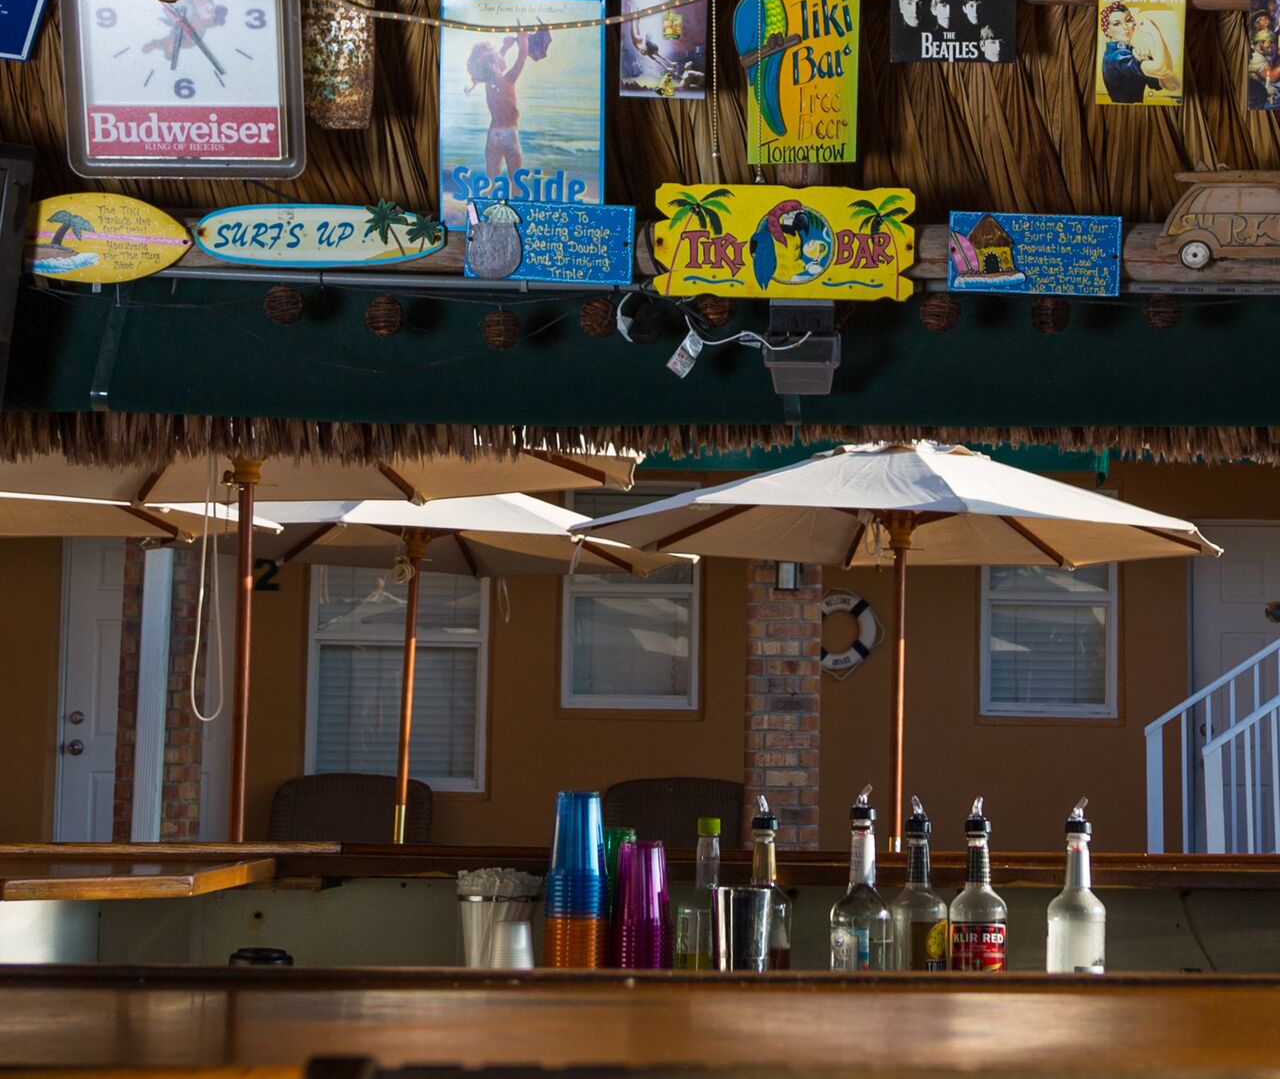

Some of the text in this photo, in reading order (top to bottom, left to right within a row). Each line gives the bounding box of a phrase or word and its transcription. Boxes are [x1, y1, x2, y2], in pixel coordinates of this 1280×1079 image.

[96, 7, 268, 30] 9 3
[943, 32, 955, 41] THE
[921, 37, 978, 62] BEATLES
[791, 45, 851, 86] Bar
[173, 77, 197, 100] 6
[91, 113, 276, 145] Budweiser
[144, 143, 171, 152] KING
[173, 143, 186, 152] OF
[760, 138, 846, 162] Tomorrow
[527, 208, 589, 223] Here's To
[1012, 220, 1064, 233] Welcome
[1068, 221, 1082, 233] To
[213, 221, 312, 249] SURF'S
[526, 223, 568, 242] Acting
[525, 237, 607, 257] Seeing Double
[681, 230, 893, 278] TIKI BAR
[526, 252, 552, 266] And
[254, 558, 280, 592] 2
[953, 932, 1004, 945] KLIR RED
